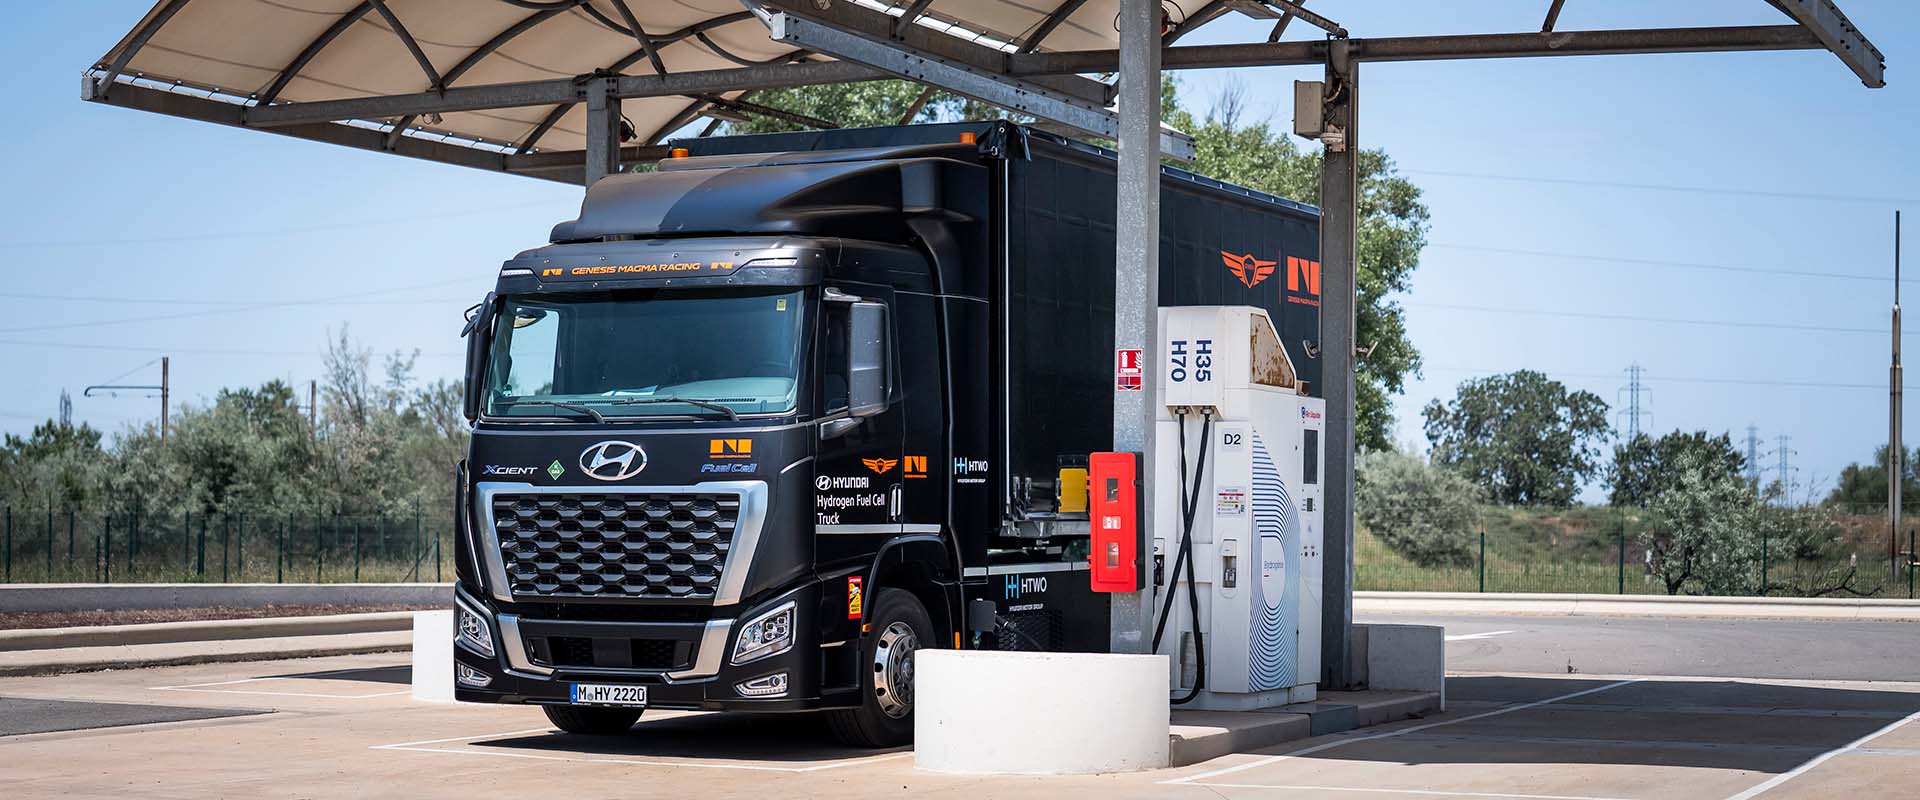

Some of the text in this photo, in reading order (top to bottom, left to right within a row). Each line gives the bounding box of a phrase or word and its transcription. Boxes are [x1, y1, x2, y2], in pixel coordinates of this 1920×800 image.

[571, 262, 701, 275] GENESIS MAGMA RACING
[1171, 340, 1187, 382] H70
[1195, 340, 1212, 382] H35
[1224, 433, 1241, 445] D2
[482, 464, 539, 475] XCIENT
[968, 460, 989, 472] HTWO
[833, 477, 869, 489] HYUNDAI
[817, 493, 886, 510] Hydrogen Fuel Cell
[817, 512, 840, 525] Truck
[1021, 576, 1048, 593] HTWO
[578, 686, 587, 700] M
[594, 686, 611, 701] HY
[613, 687, 645, 702] 2220
